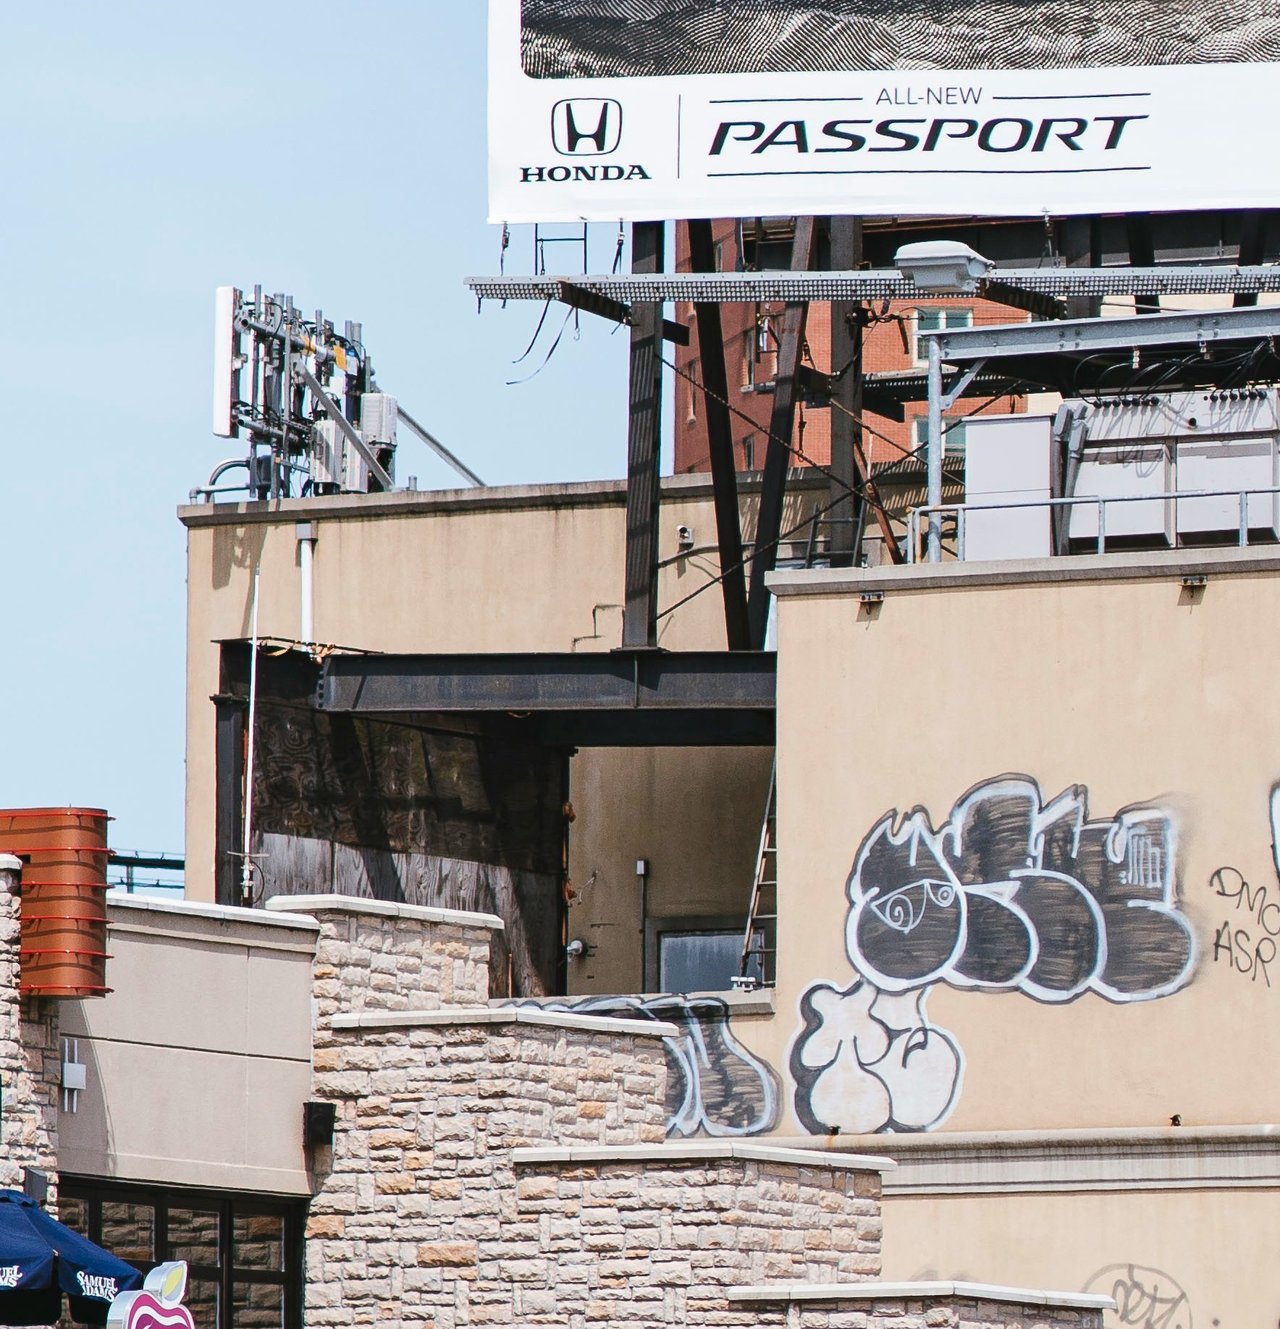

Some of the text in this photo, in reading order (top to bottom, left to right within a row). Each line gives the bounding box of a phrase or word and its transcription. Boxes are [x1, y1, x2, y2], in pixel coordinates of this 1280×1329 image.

[876, 86, 983, 106] ALL-NEW
[708, 114, 1151, 156] PASSPORT
[519, 164, 653, 183] HONDA
[76, 1270, 119, 1292] SAMUEL
